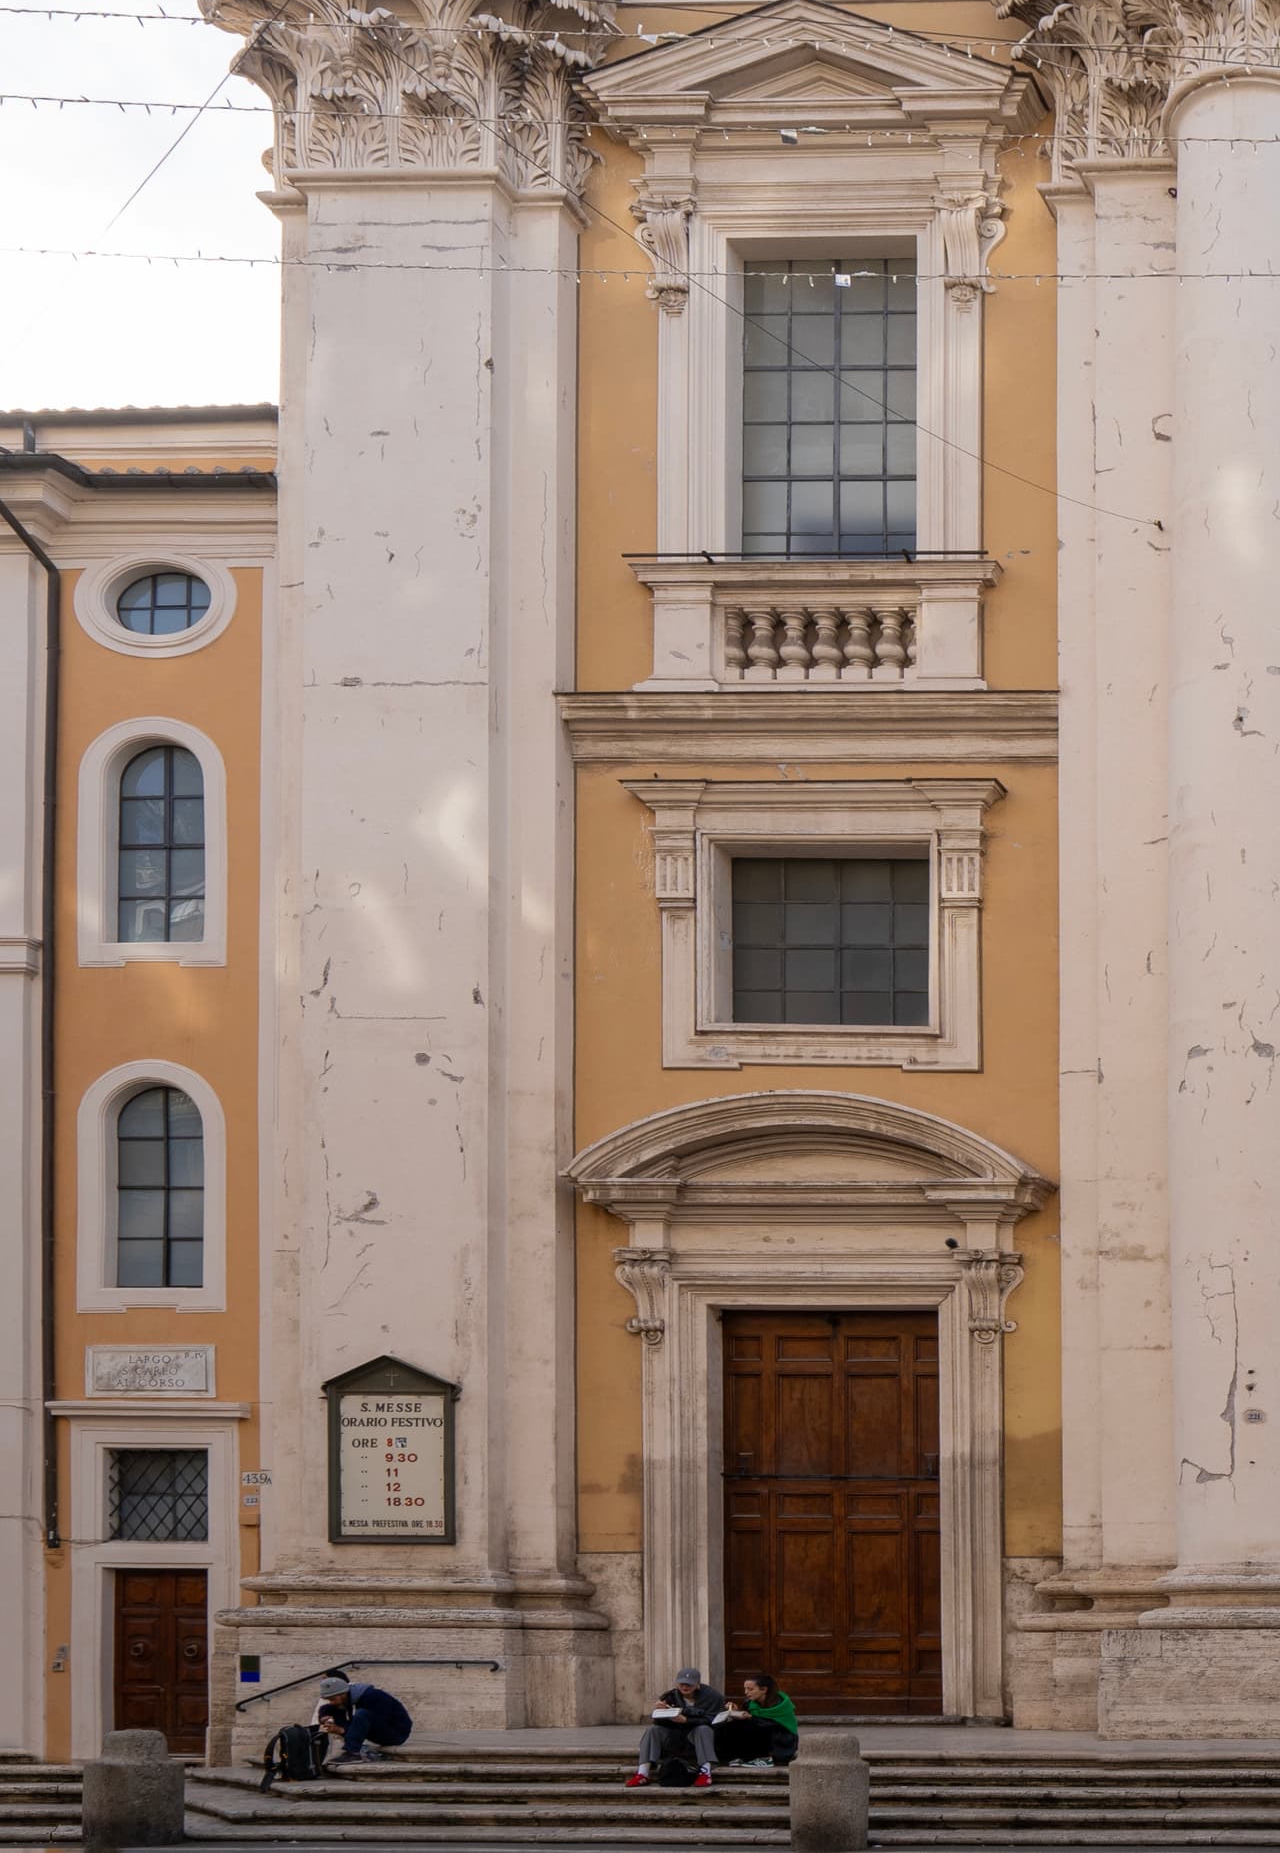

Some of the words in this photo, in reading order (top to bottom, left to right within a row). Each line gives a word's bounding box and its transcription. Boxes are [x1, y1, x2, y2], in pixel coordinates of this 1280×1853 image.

[129, 1355, 172, 1364] LARGO
[135, 1366, 179, 1376] CARLO
[138, 1378, 185, 1387] CORSO
[360, 1402, 371, 1413] S.
[375, 1402, 422, 1413] MESSE
[341, 1417, 388, 1427] ORARIO
[391, 1417, 443, 1427] FESTIVO
[351, 1438, 378, 1448] ORE
[386, 1468, 398, 1477] 11
[386, 1482, 401, 1492] 12
